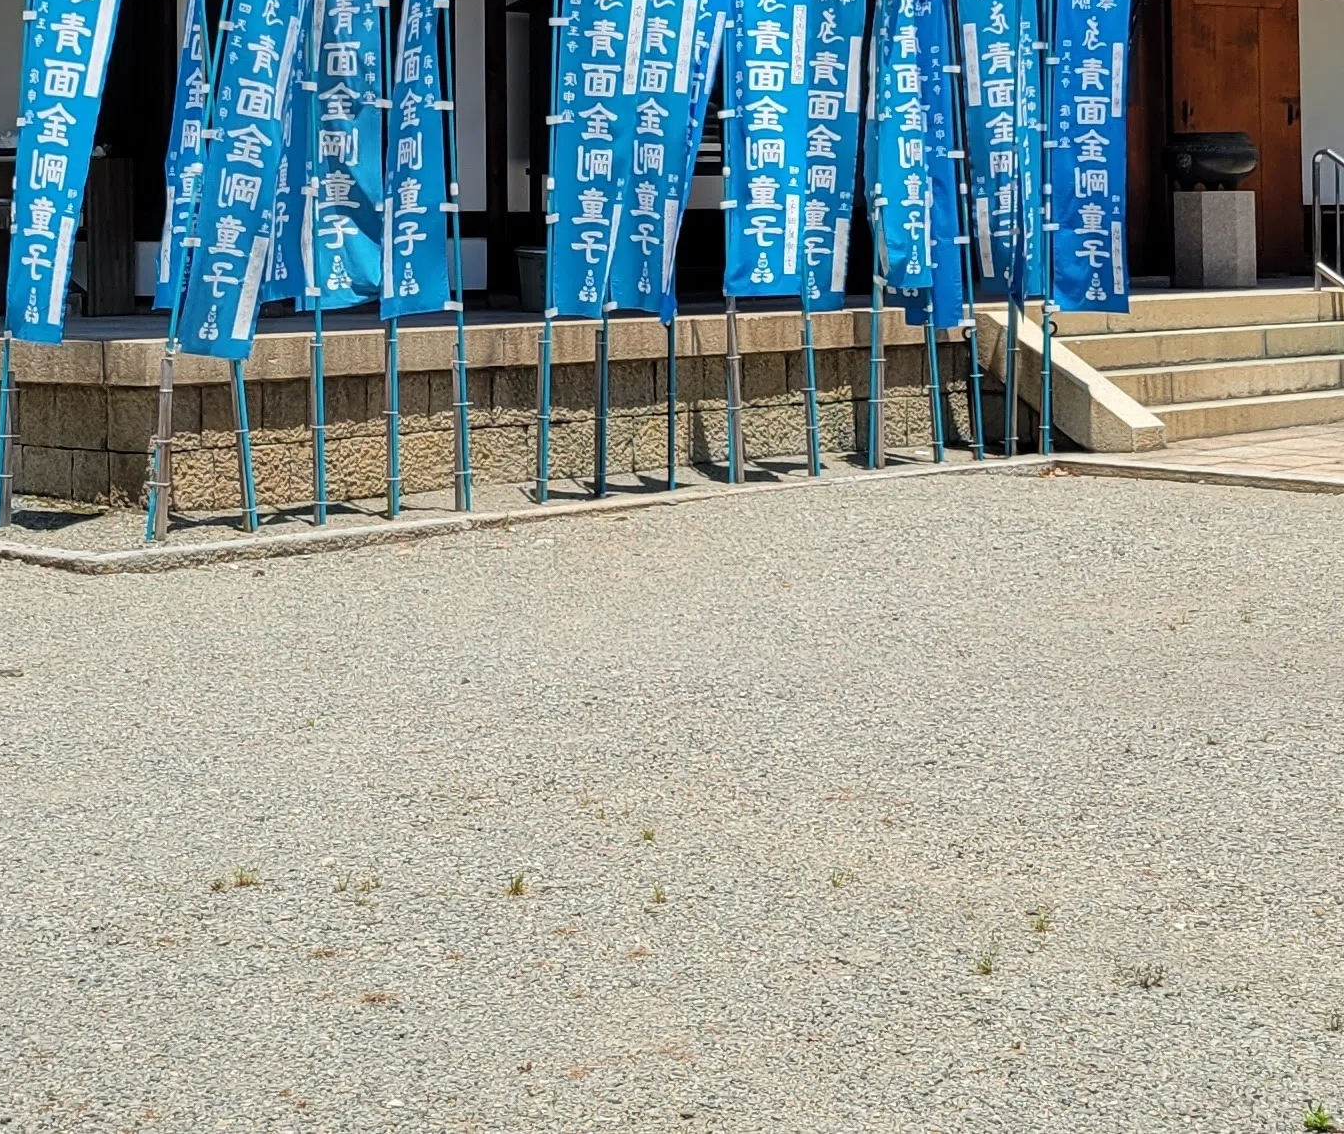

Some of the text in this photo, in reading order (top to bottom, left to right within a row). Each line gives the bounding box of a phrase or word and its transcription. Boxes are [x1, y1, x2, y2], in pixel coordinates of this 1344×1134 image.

[363, 52, 377, 106] 庚申堂
[394, 2, 428, 256] 青面金剛童子
